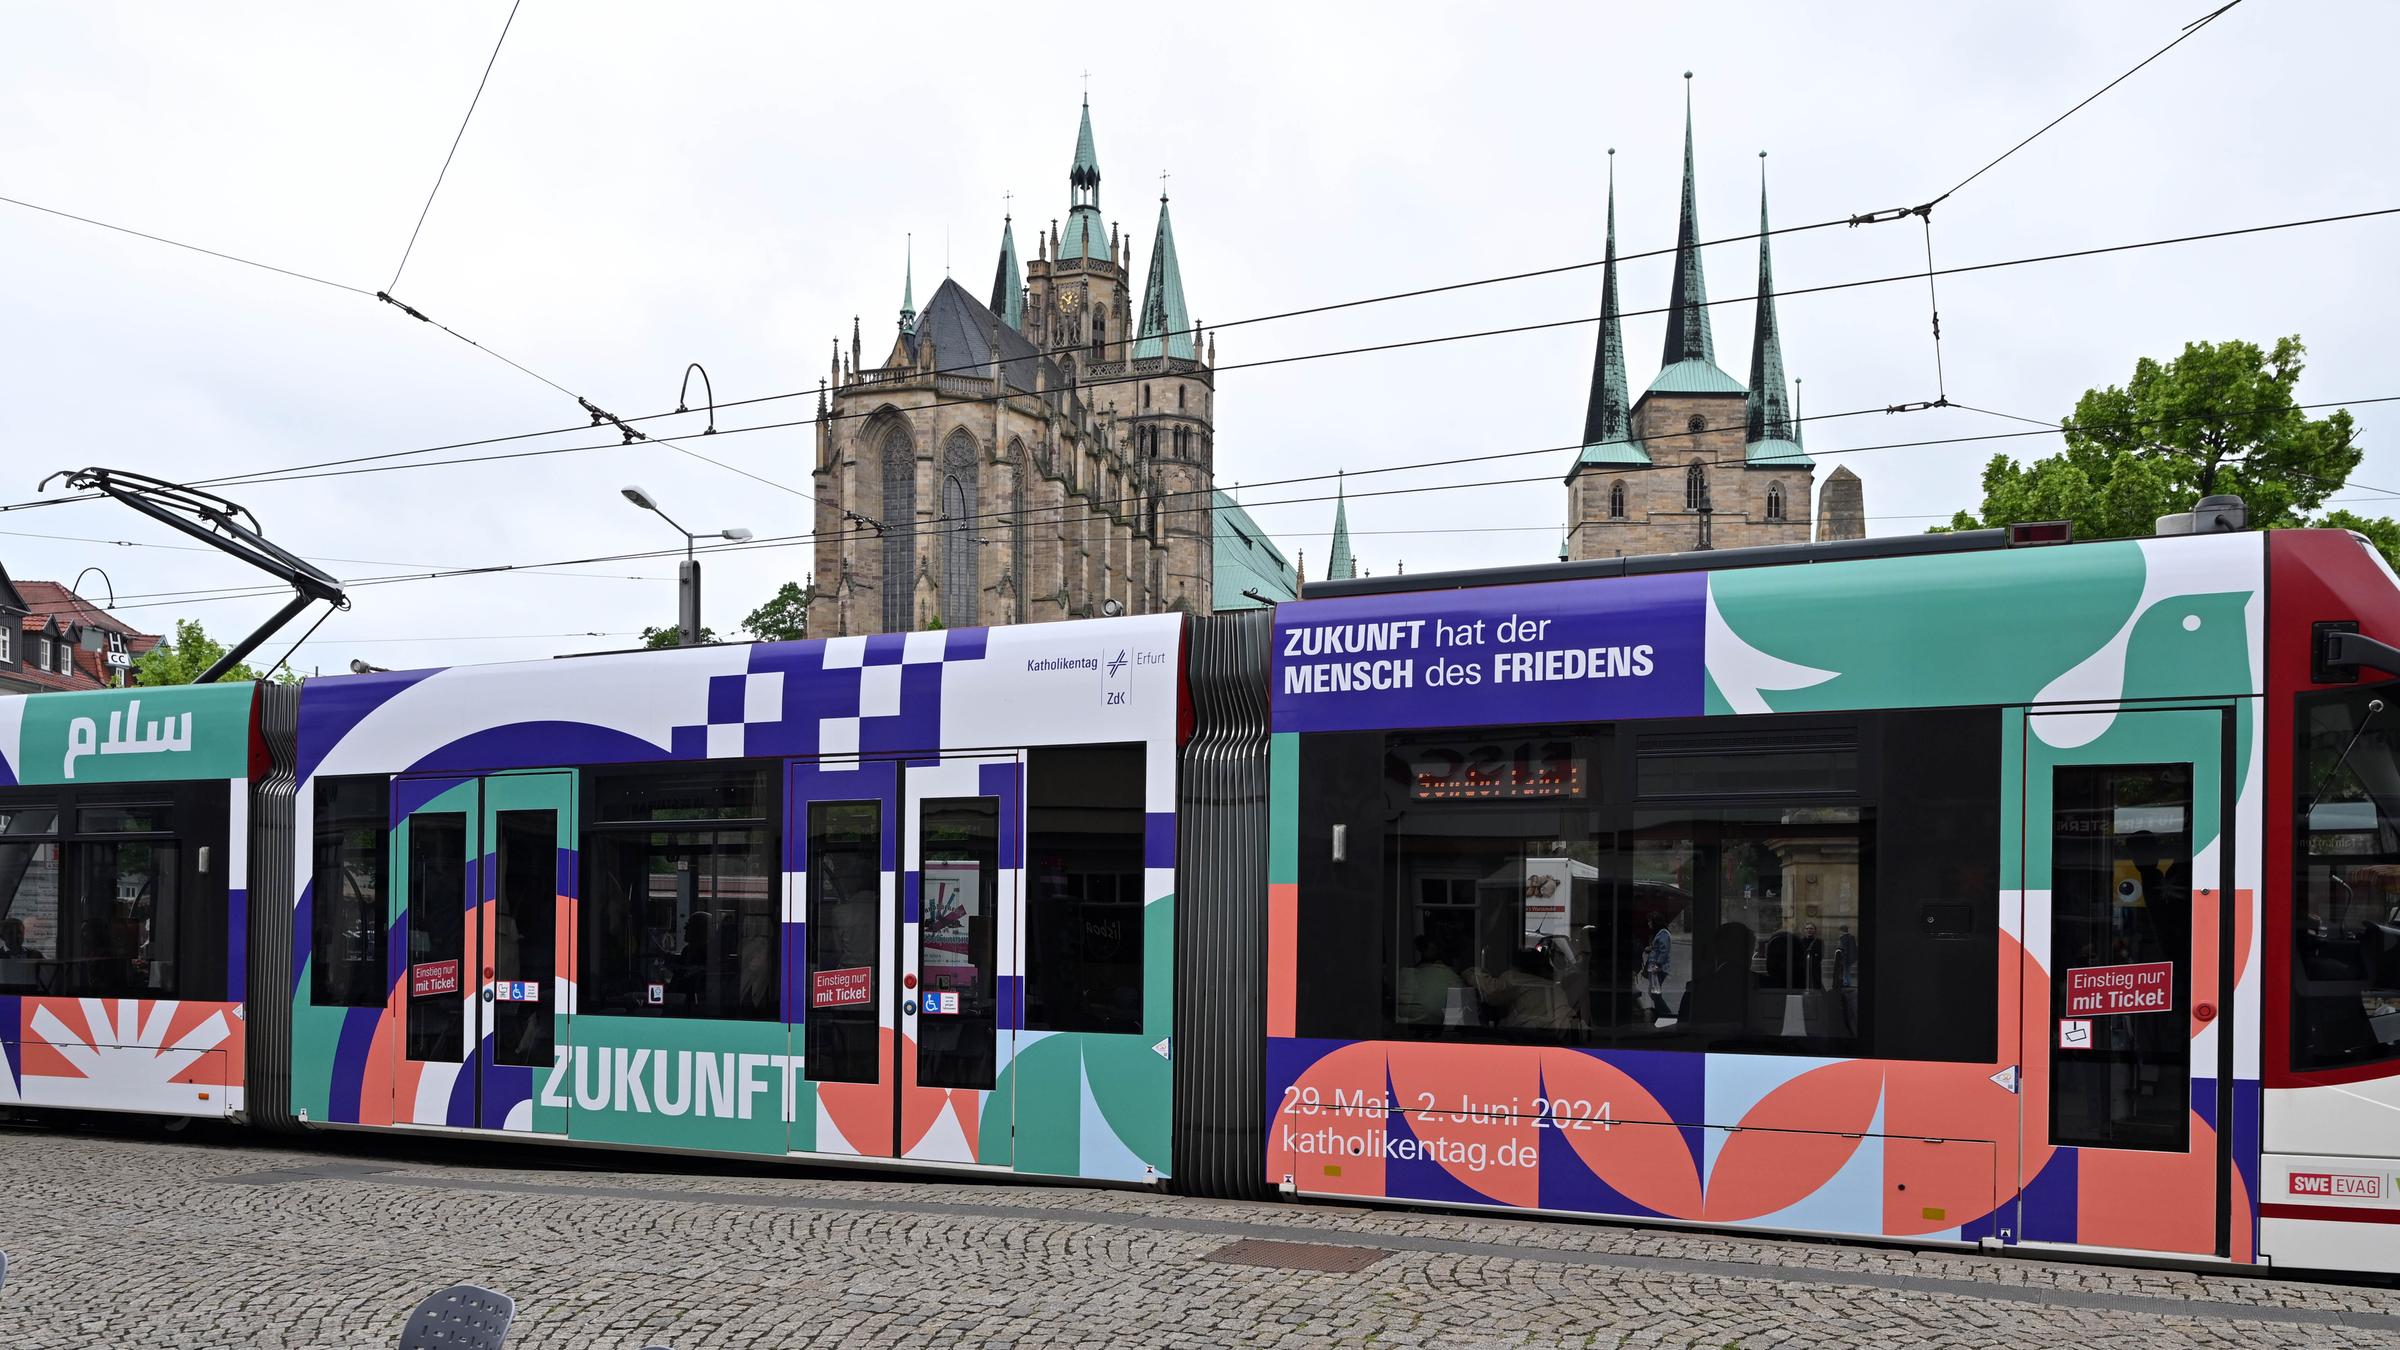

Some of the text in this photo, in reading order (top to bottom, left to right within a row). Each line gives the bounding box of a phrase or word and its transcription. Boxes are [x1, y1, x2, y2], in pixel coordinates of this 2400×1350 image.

[1284, 614, 1552, 656] ZUKUNFT hat der
[1027, 657, 1098, 672] Katholikentag
[1136, 651, 1166, 665] Erfurt
[1284, 644, 1654, 694] MENSCH des FRIEDENS
[63, 699, 192, 779] سلام
[416, 965, 455, 978] Einstieg nur
[817, 974, 866, 987] Einstieg nur
[2074, 971, 2165, 989] Einstieg nur
[415, 977, 455, 992] mit Ticket
[816, 986, 867, 1002] mit Ticket
[2073, 988, 2165, 1010] mit Ticket
[540, 1045, 805, 1122] ZUKUNFT
[1284, 1086, 1612, 1131] 29. Mai 2. Juni 2024
[1283, 1124, 1537, 1172] katholikentag.de
[2294, 1176, 2376, 1194] SWE EVAG
